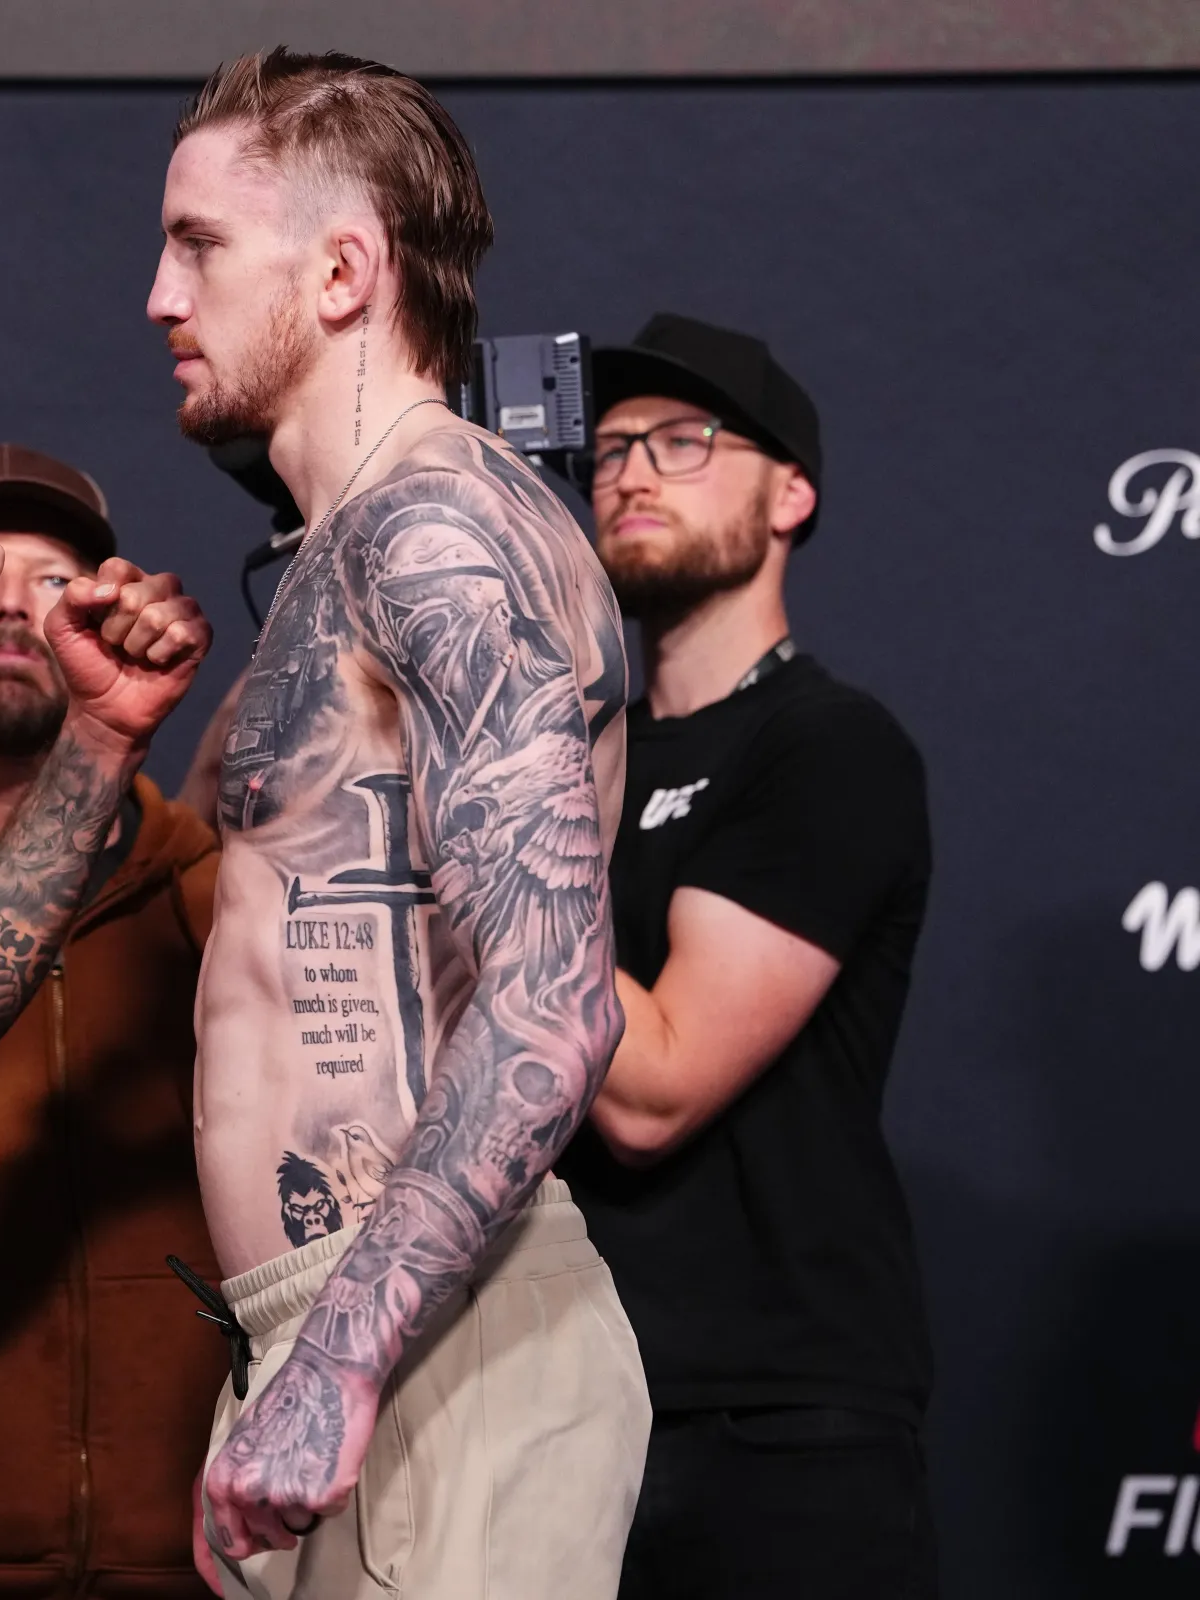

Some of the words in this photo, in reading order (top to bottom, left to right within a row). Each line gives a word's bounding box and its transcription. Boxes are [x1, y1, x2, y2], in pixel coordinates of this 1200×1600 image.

[639, 777, 710, 830] UFC
[286, 920, 330, 951] LUKE
[334, 921, 374, 950] 12:48
[304, 964, 317, 983] to
[319, 962, 358, 983] whom
[293, 993, 326, 1015] much
[328, 993, 338, 1014] is
[340, 993, 380, 1018] given,
[302, 1024, 333, 1045] much
[335, 1024, 358, 1043] will
[361, 1023, 377, 1042] be
[1104, 1473, 1200, 1557] FI
